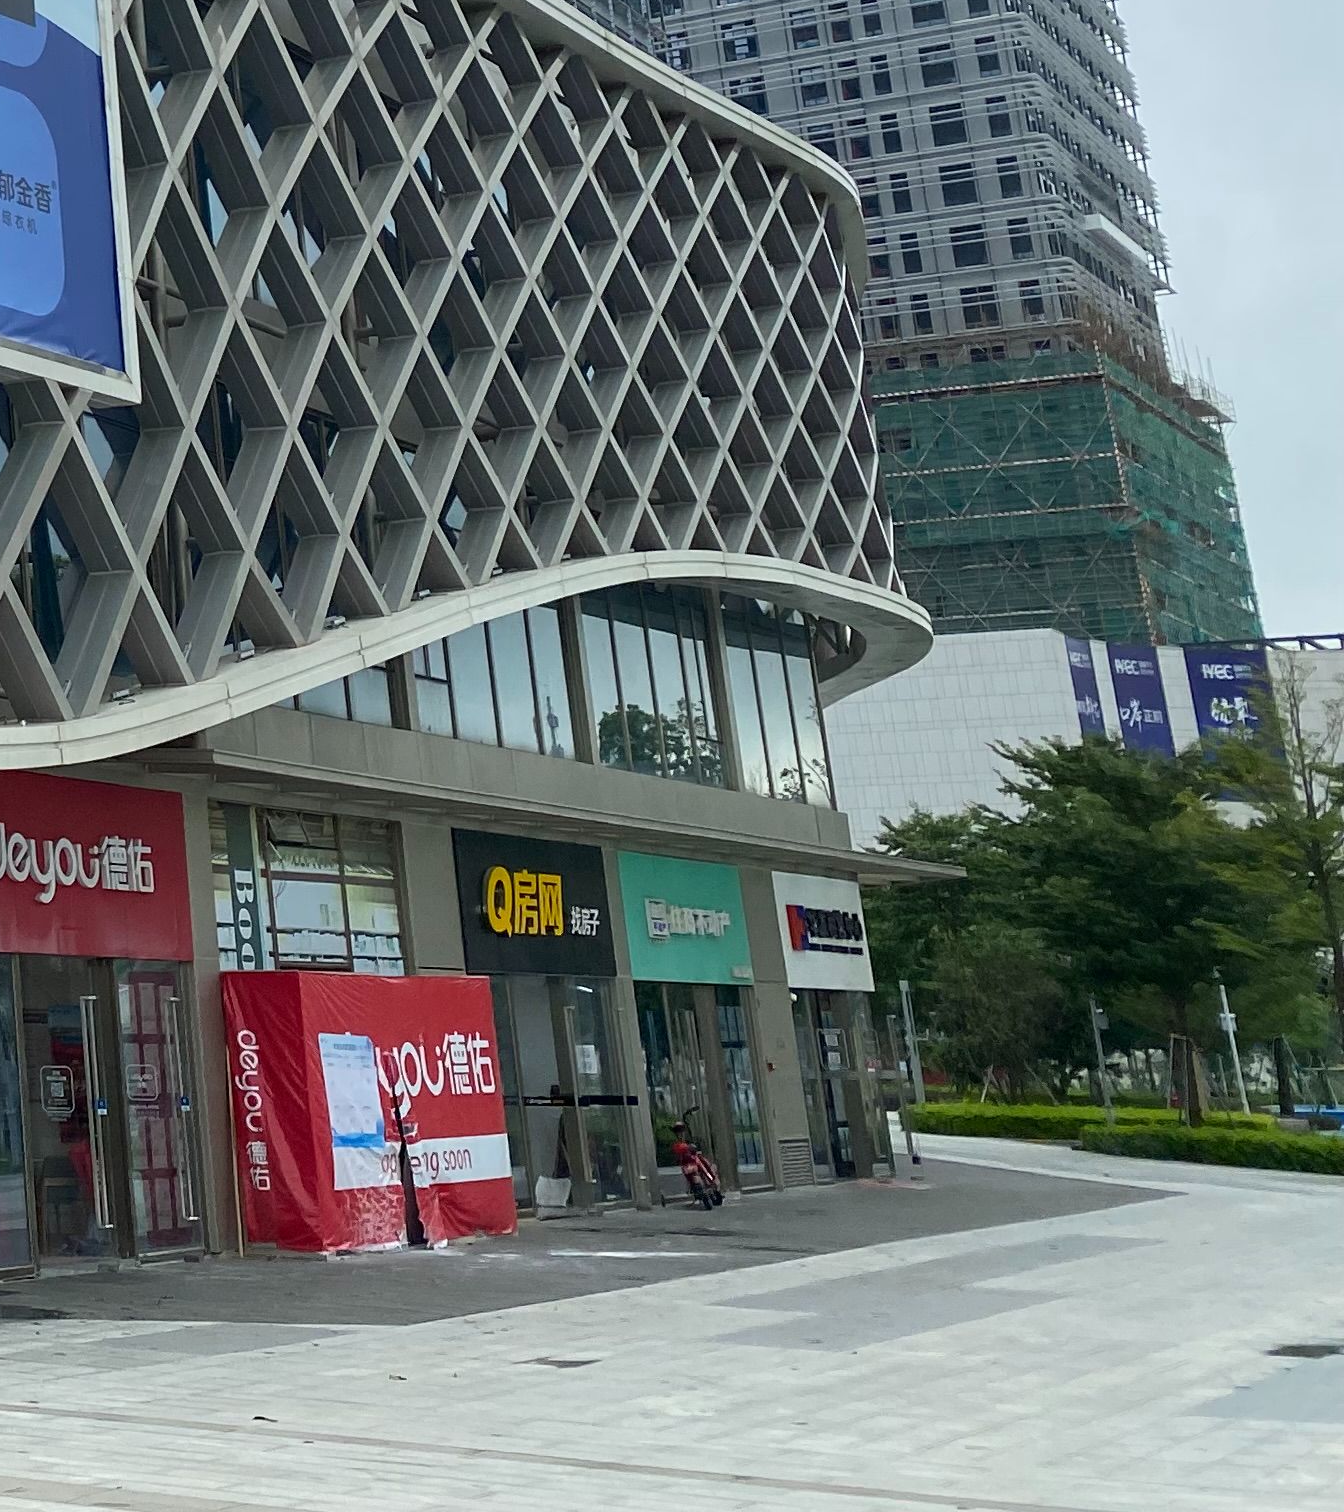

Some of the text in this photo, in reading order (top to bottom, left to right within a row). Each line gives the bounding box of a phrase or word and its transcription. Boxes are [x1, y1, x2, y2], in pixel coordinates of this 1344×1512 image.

[100, 835, 155, 893] 德佑
[484, 865, 564, 938] Q房网
[234, 1029, 264, 1134] deyou
[443, 1030, 497, 1095] 德佑
[443, 1148, 473, 1172] soon
